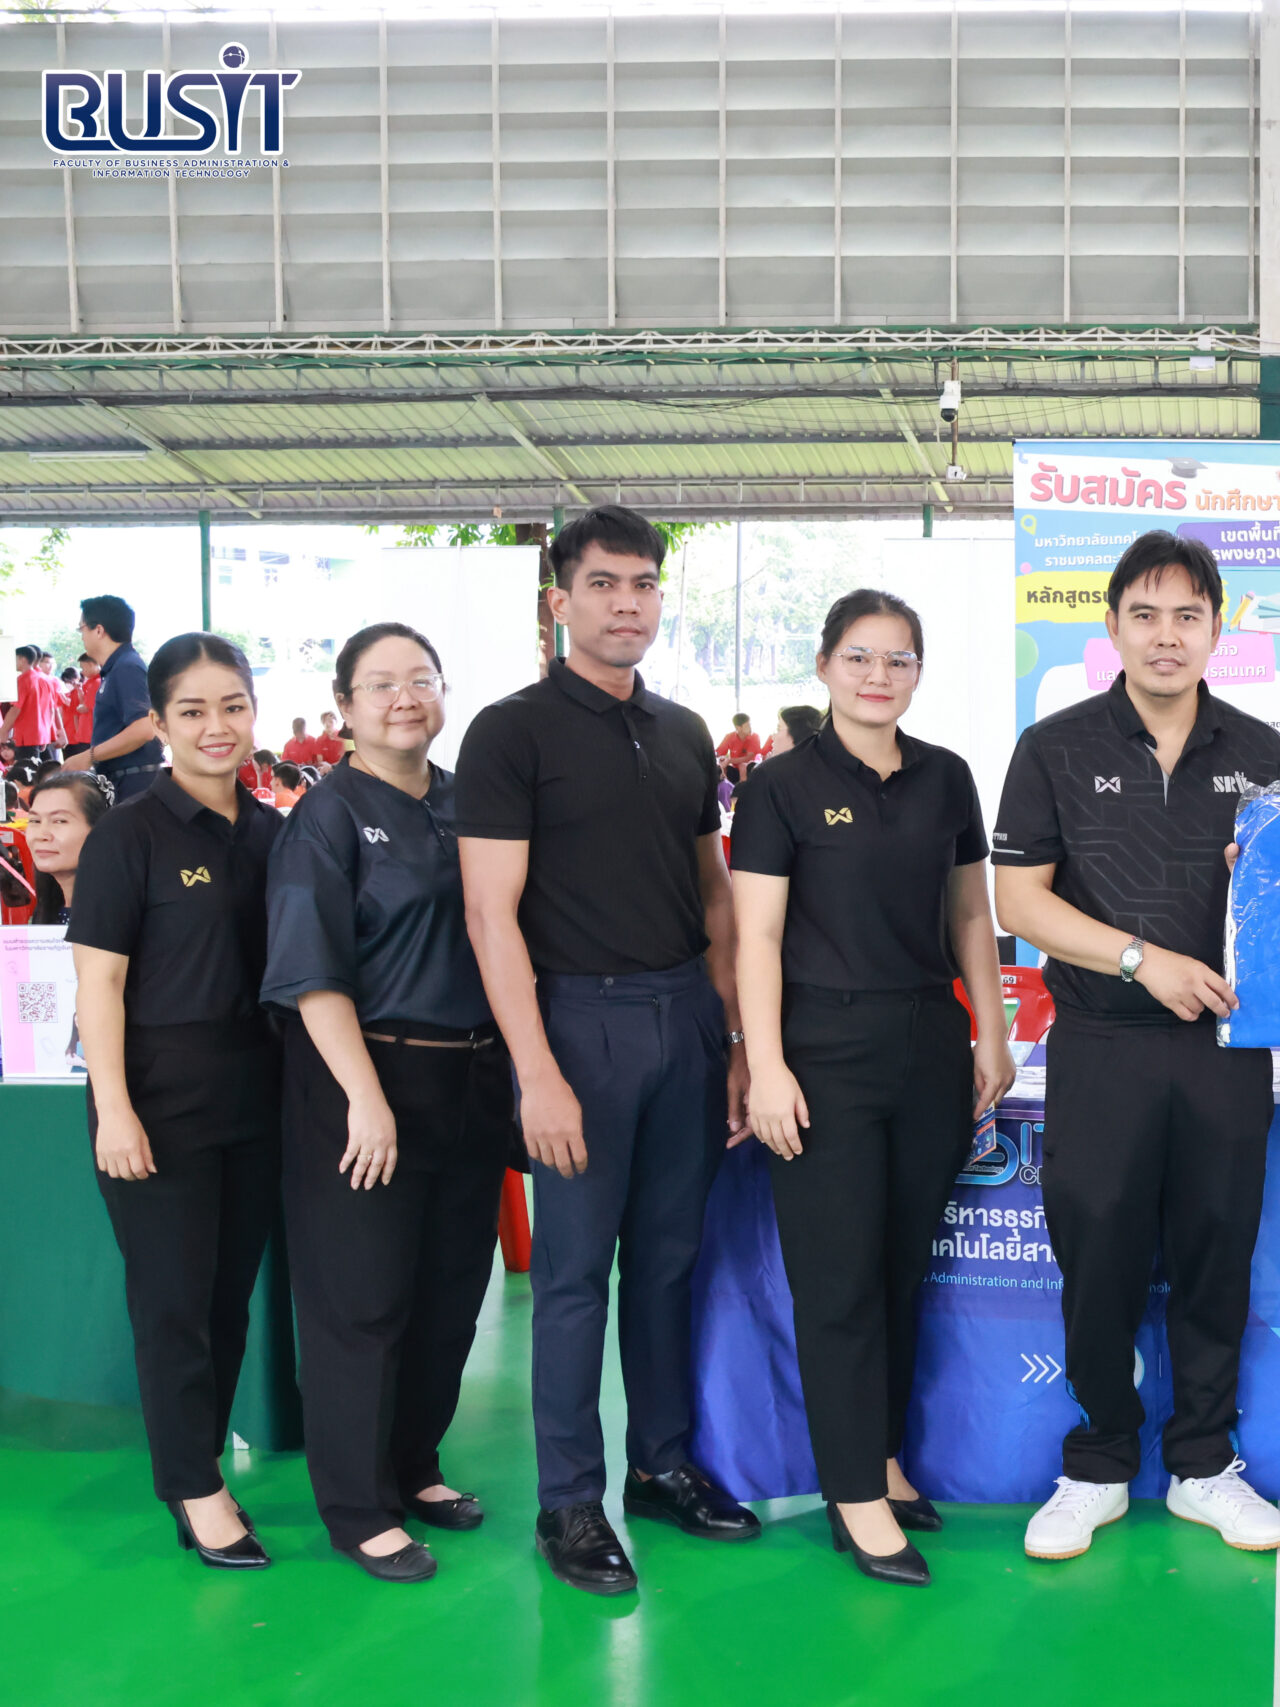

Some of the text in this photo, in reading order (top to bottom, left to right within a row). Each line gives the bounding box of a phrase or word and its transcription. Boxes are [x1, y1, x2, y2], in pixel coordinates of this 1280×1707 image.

[1030, 462, 1187, 510] รับสมัคร
[1035, 531, 1139, 548] มหาวิทยาลัยเทคโ
[930, 1271, 1018, 1288] Administration
[1021, 1276, 1043, 1289] and
